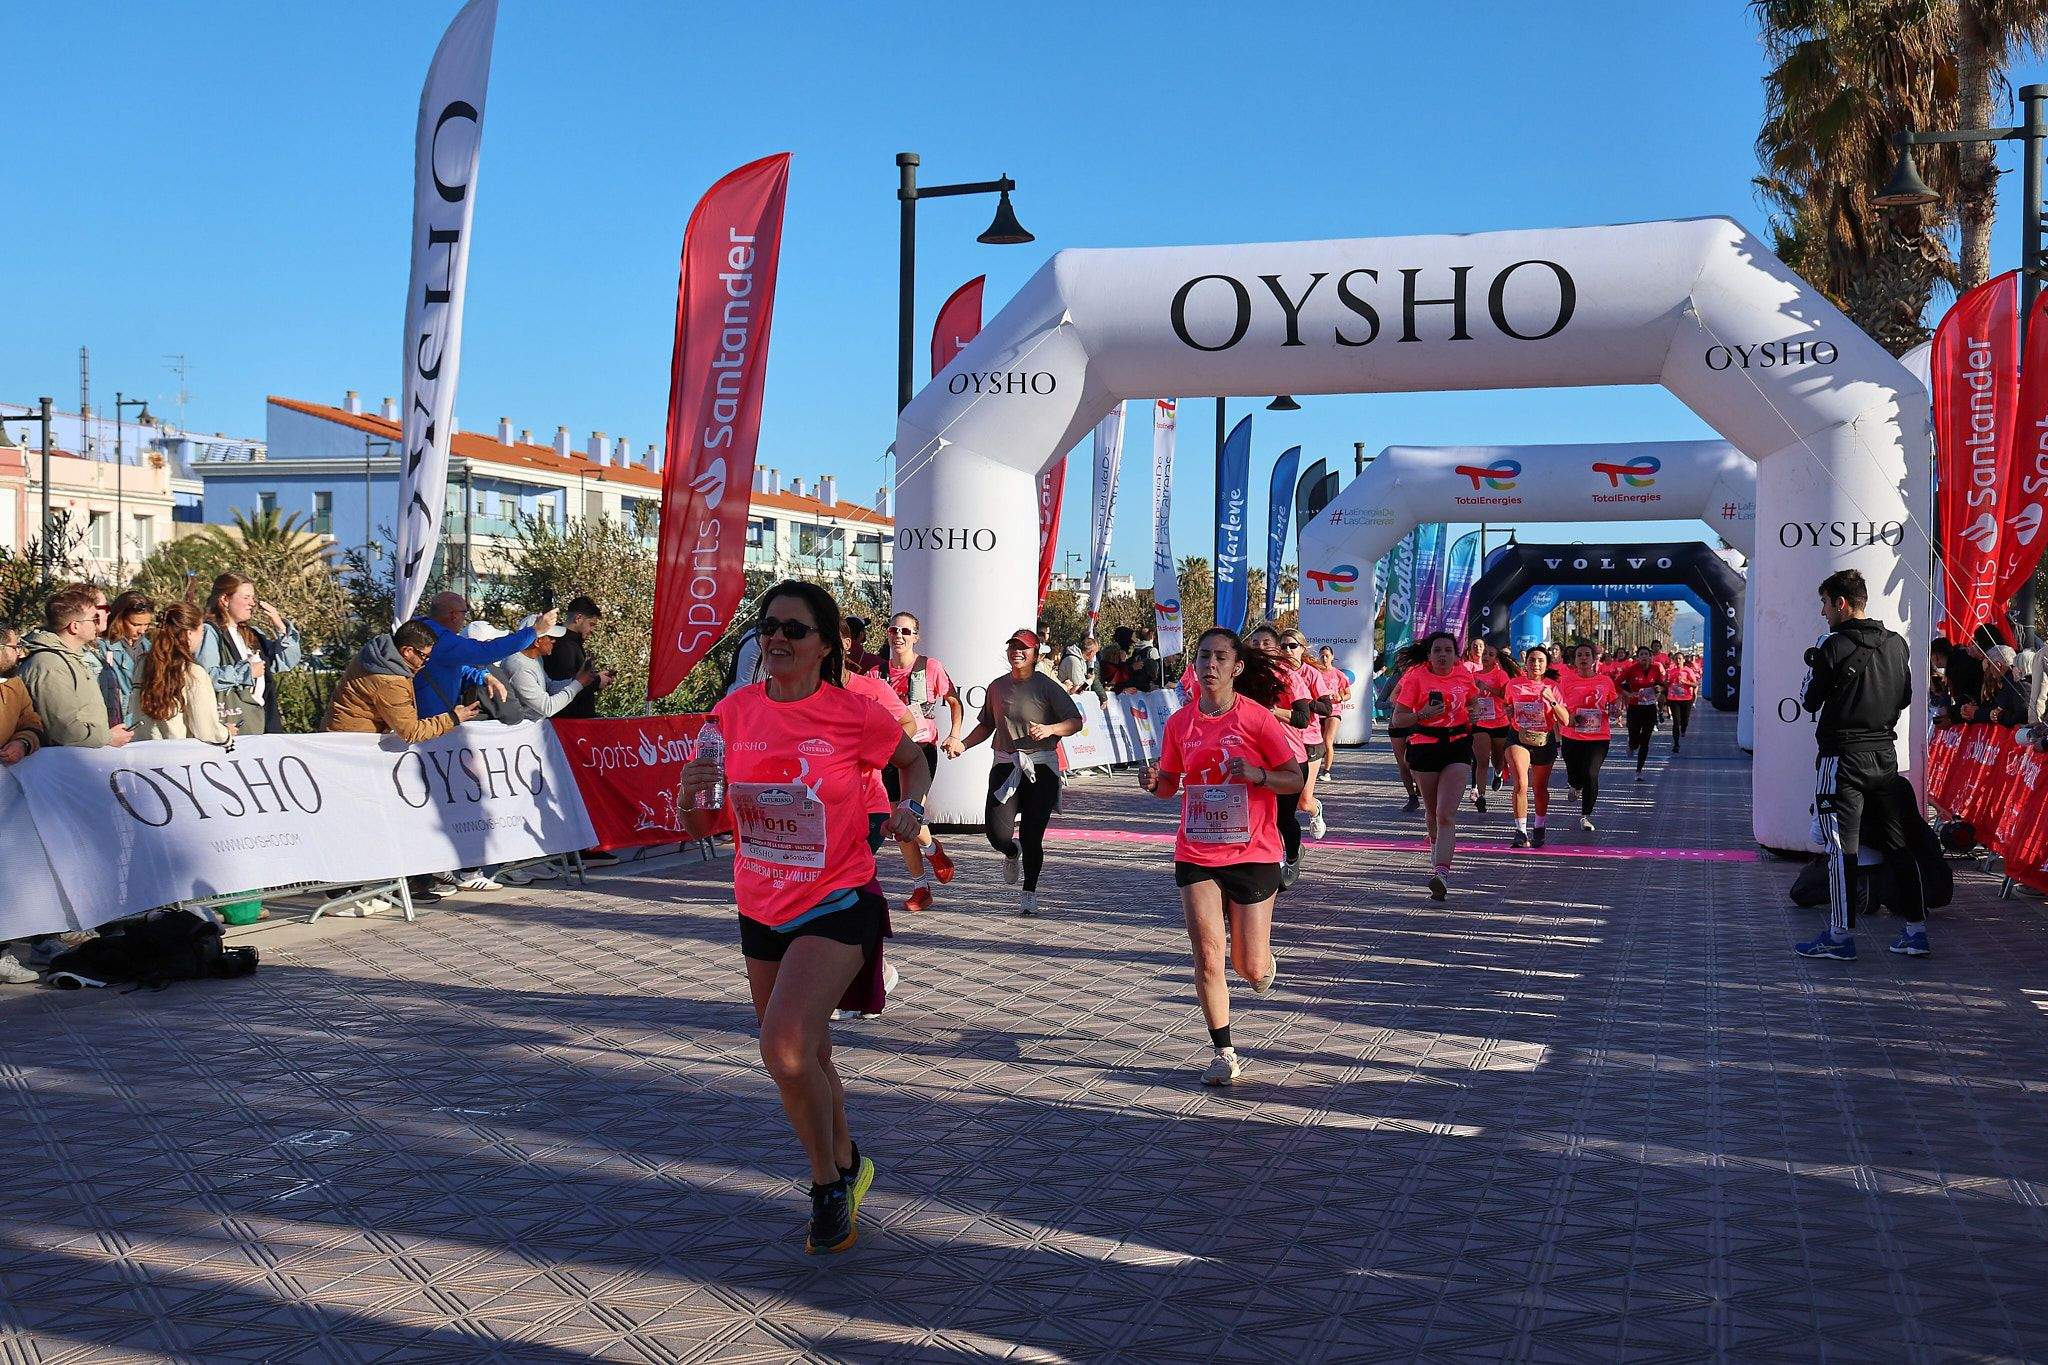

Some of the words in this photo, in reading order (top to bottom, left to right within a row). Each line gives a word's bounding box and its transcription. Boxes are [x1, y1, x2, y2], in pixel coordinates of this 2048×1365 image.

[1171, 259, 1577, 352] OYSHO
[1705, 341, 1839, 371] OYSHO
[949, 372, 1056, 394] OYSHO
[1963, 337, 1996, 507] Santander
[678, 518, 722, 653] Sports
[704, 228, 755, 449] Santander
[1455, 497, 1522, 505] TotalEnergies
[1592, 493, 1661, 503] TotalEnergies
[900, 527, 997, 551] OYSHO
[1218, 488, 1246, 583] Marlene
[1779, 521, 1904, 548] OYSHO
[1543, 557, 1672, 570] VOLVO
[1306, 598, 1358, 607] TotalEnergies
[1306, 637, 1357, 645] otalenergies.es
[1726, 606, 1736, 698] VOLVO
[733, 741, 767, 752] OYSHO
[392, 744, 544, 808] OYSHO
[110, 756, 322, 827] OYSHO
[764, 817, 798, 833] 016
[1205, 810, 1229, 821] 016
[772, 868, 784, 878] DE
